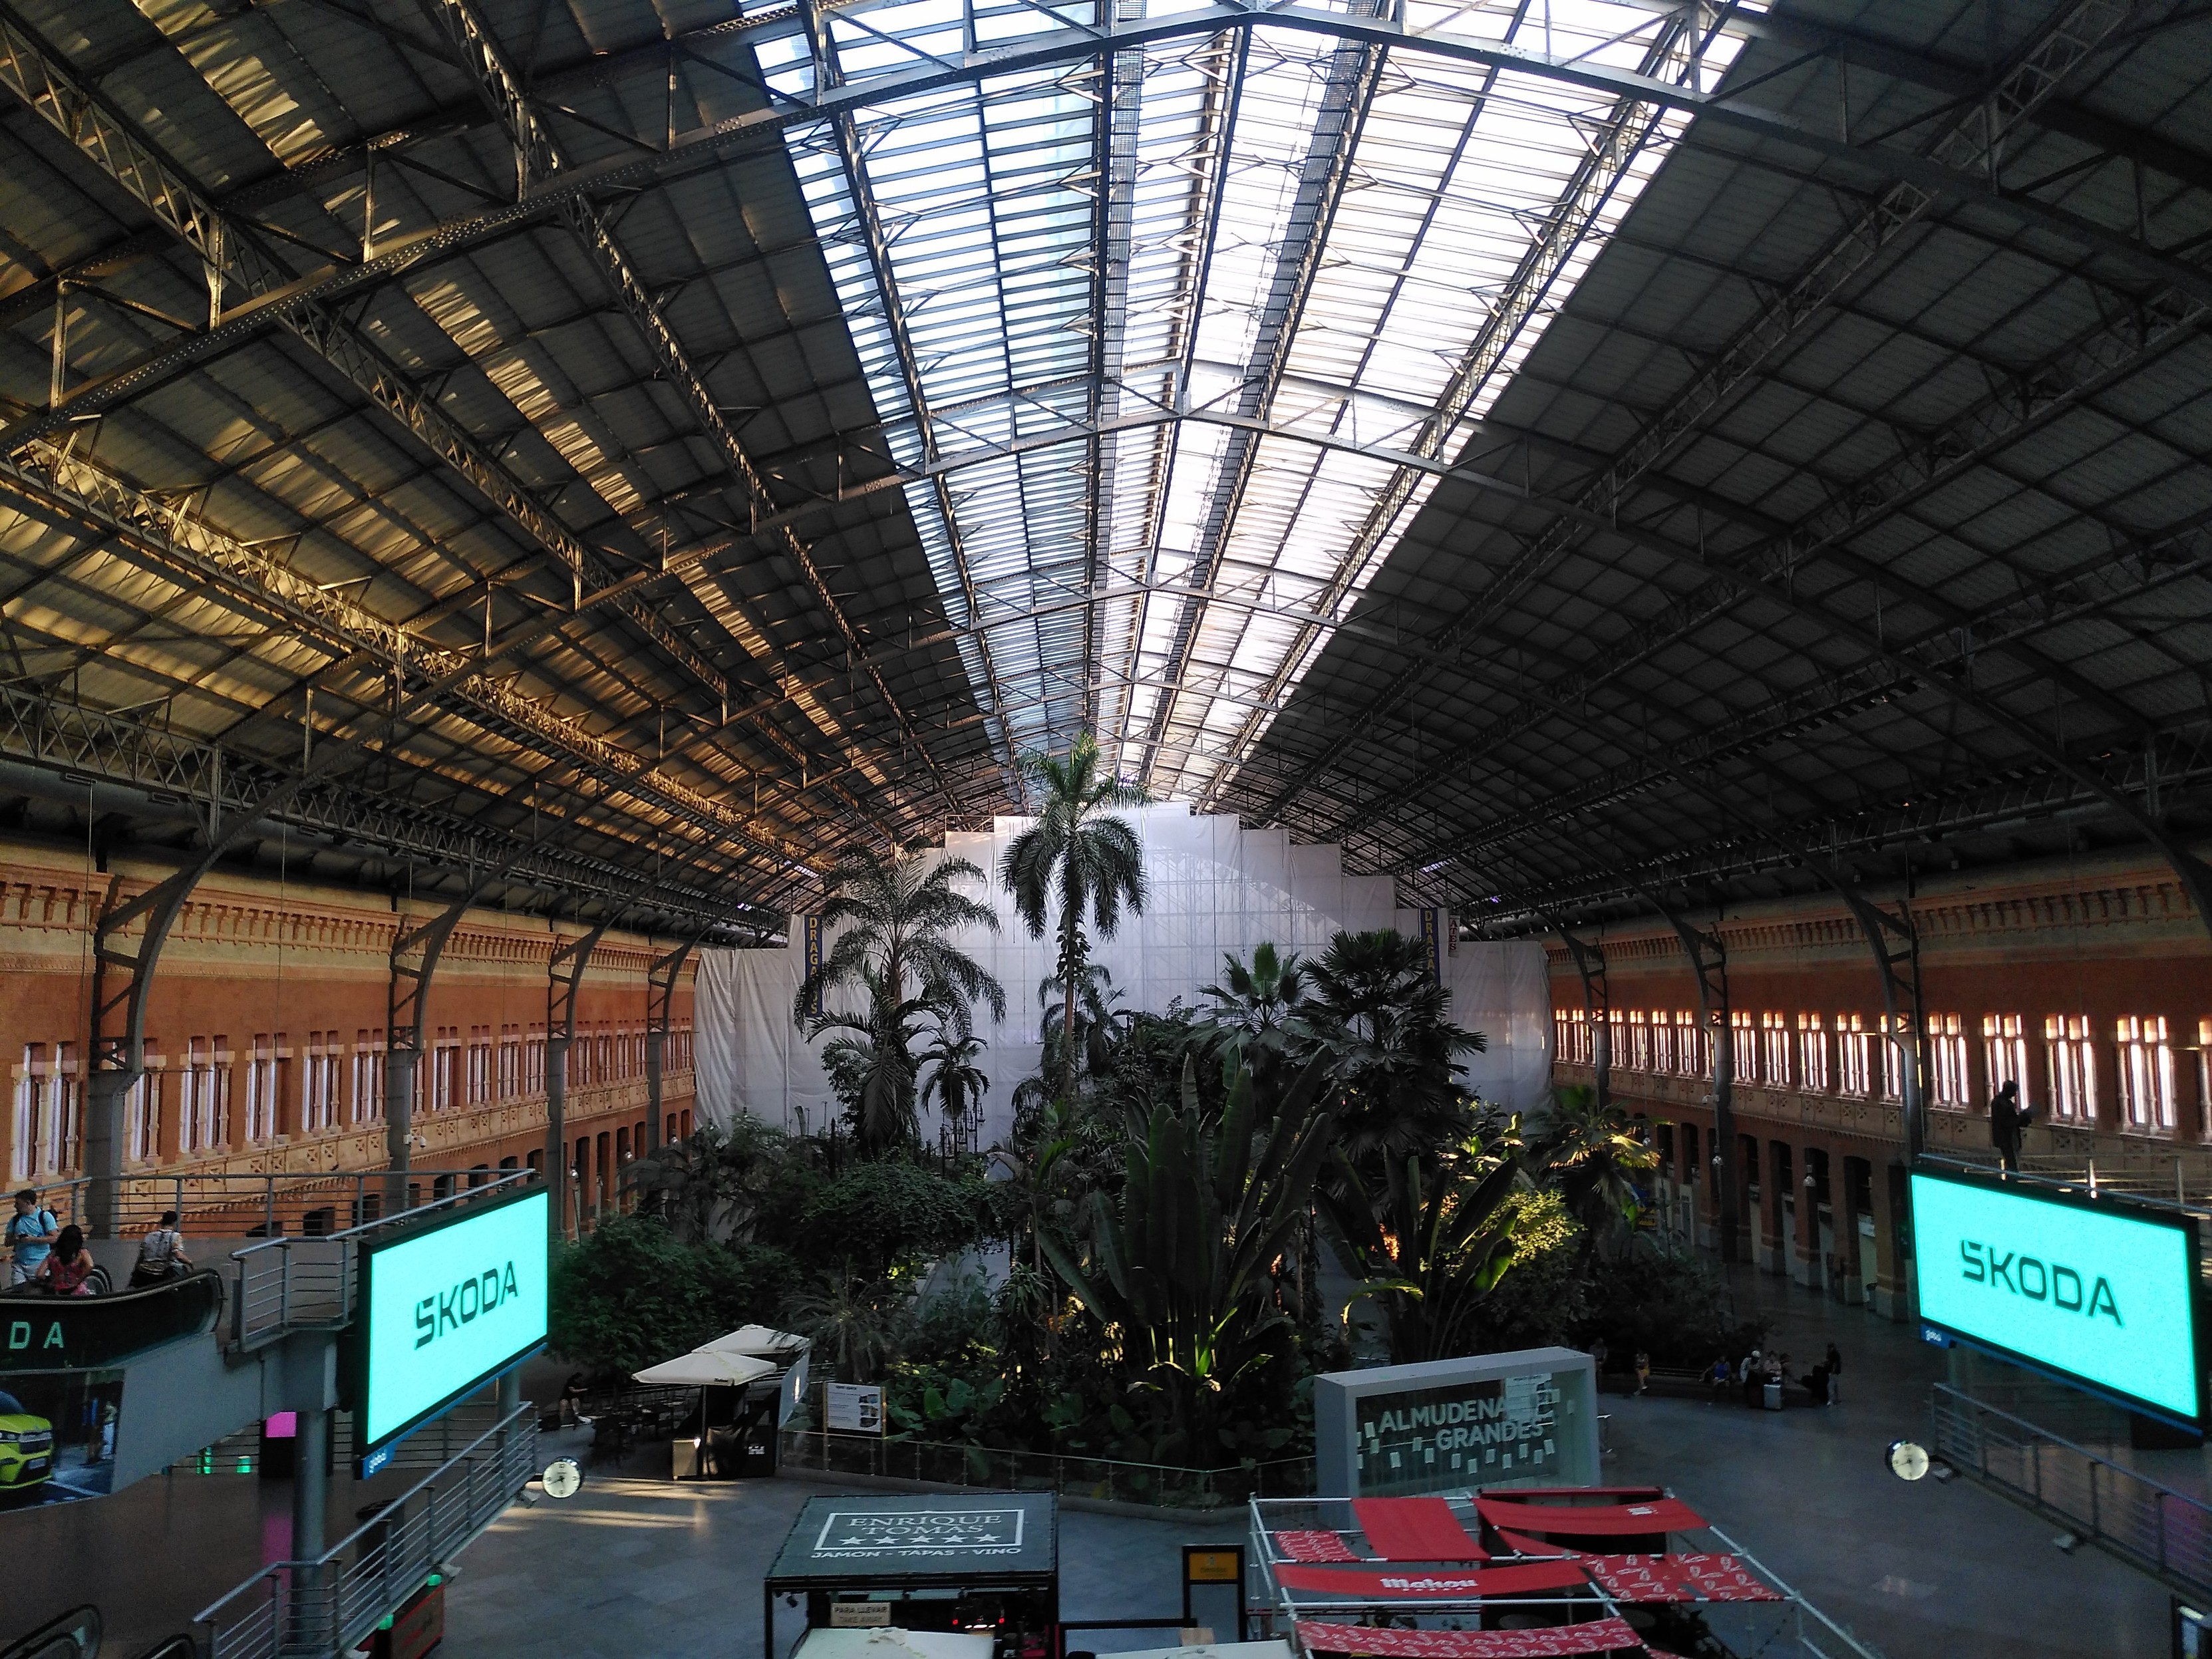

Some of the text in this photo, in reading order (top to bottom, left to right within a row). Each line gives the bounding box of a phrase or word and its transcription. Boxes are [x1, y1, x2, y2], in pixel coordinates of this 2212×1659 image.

[810, 917, 818, 1014] DRAGAS
[1378, 1398, 1507, 1433] ALMUDENA
[1435, 1420, 1544, 1451] GRANDES
[846, 1515, 1002, 1527] ENRIQUE
